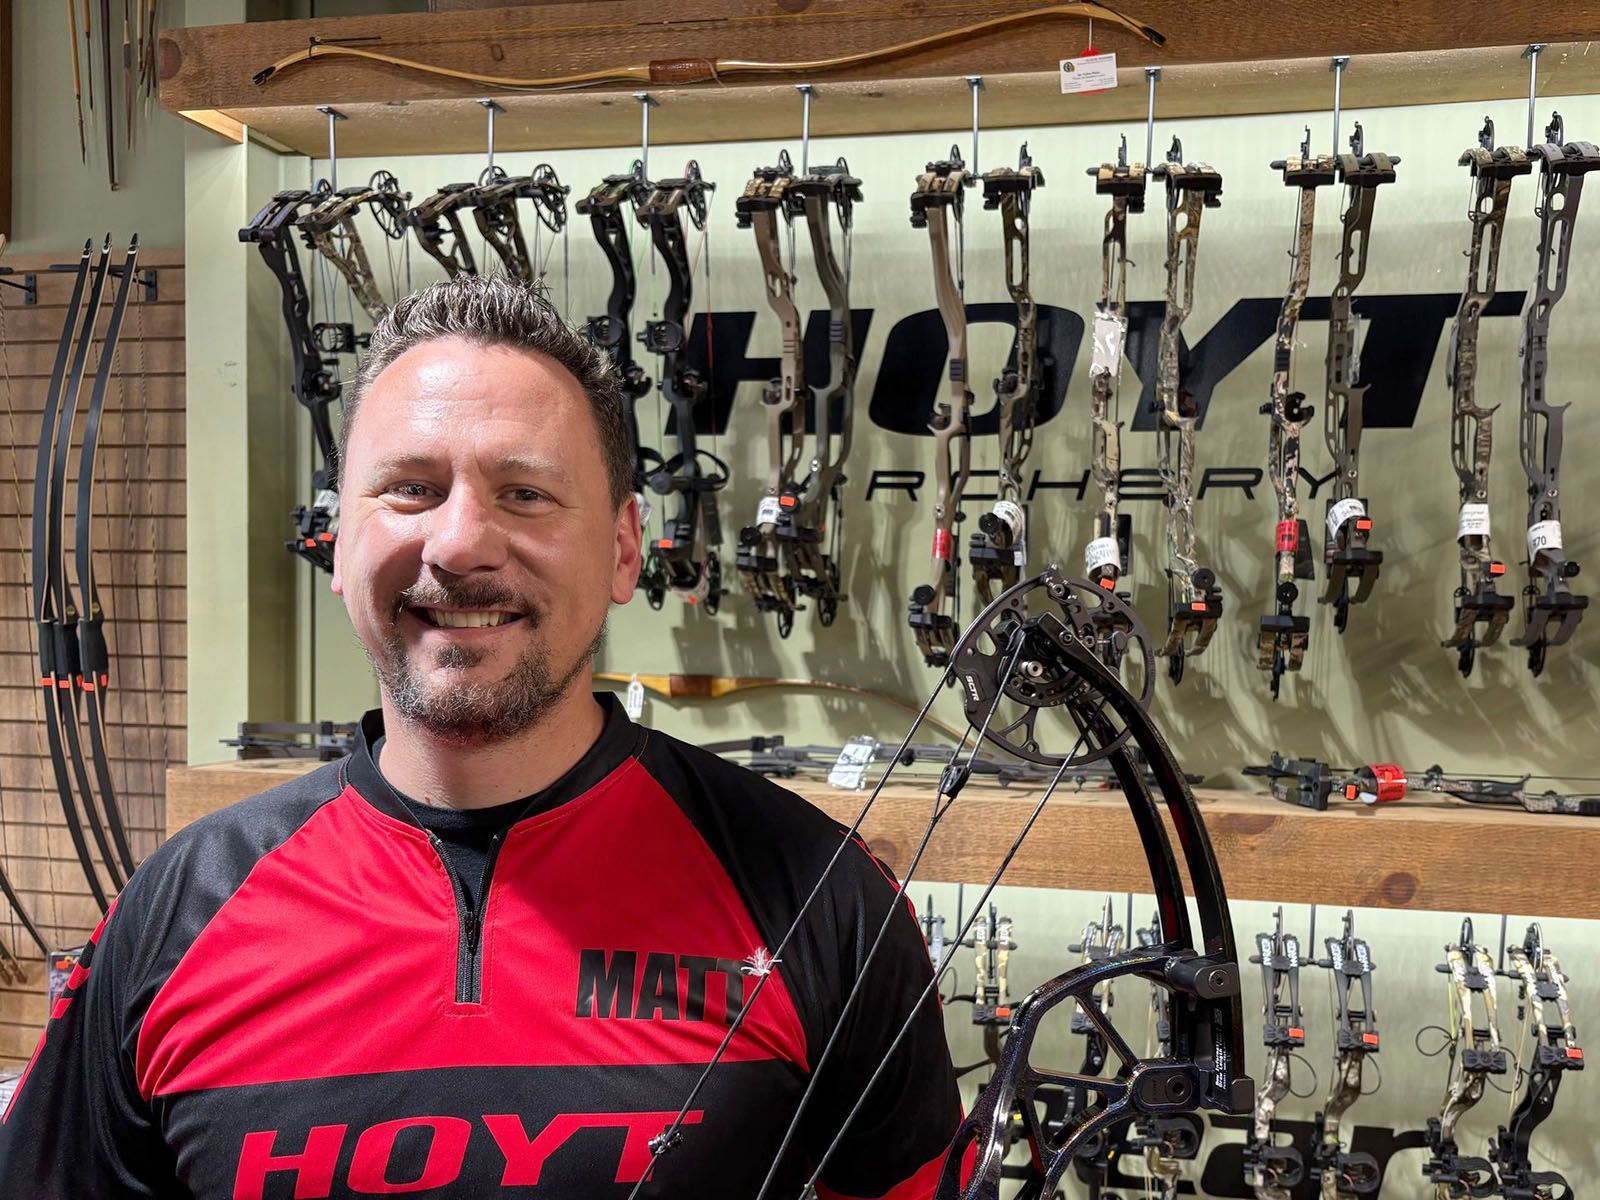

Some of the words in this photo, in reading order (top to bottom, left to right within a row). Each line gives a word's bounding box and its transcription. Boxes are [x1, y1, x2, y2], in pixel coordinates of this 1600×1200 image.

[664, 291, 1527, 436] HOYT
[800, 468, 1342, 501] RCHERY
[965, 675, 980, 702] SCTR
[576, 949, 754, 1025] MATT
[232, 1110, 705, 1200] HOYT
